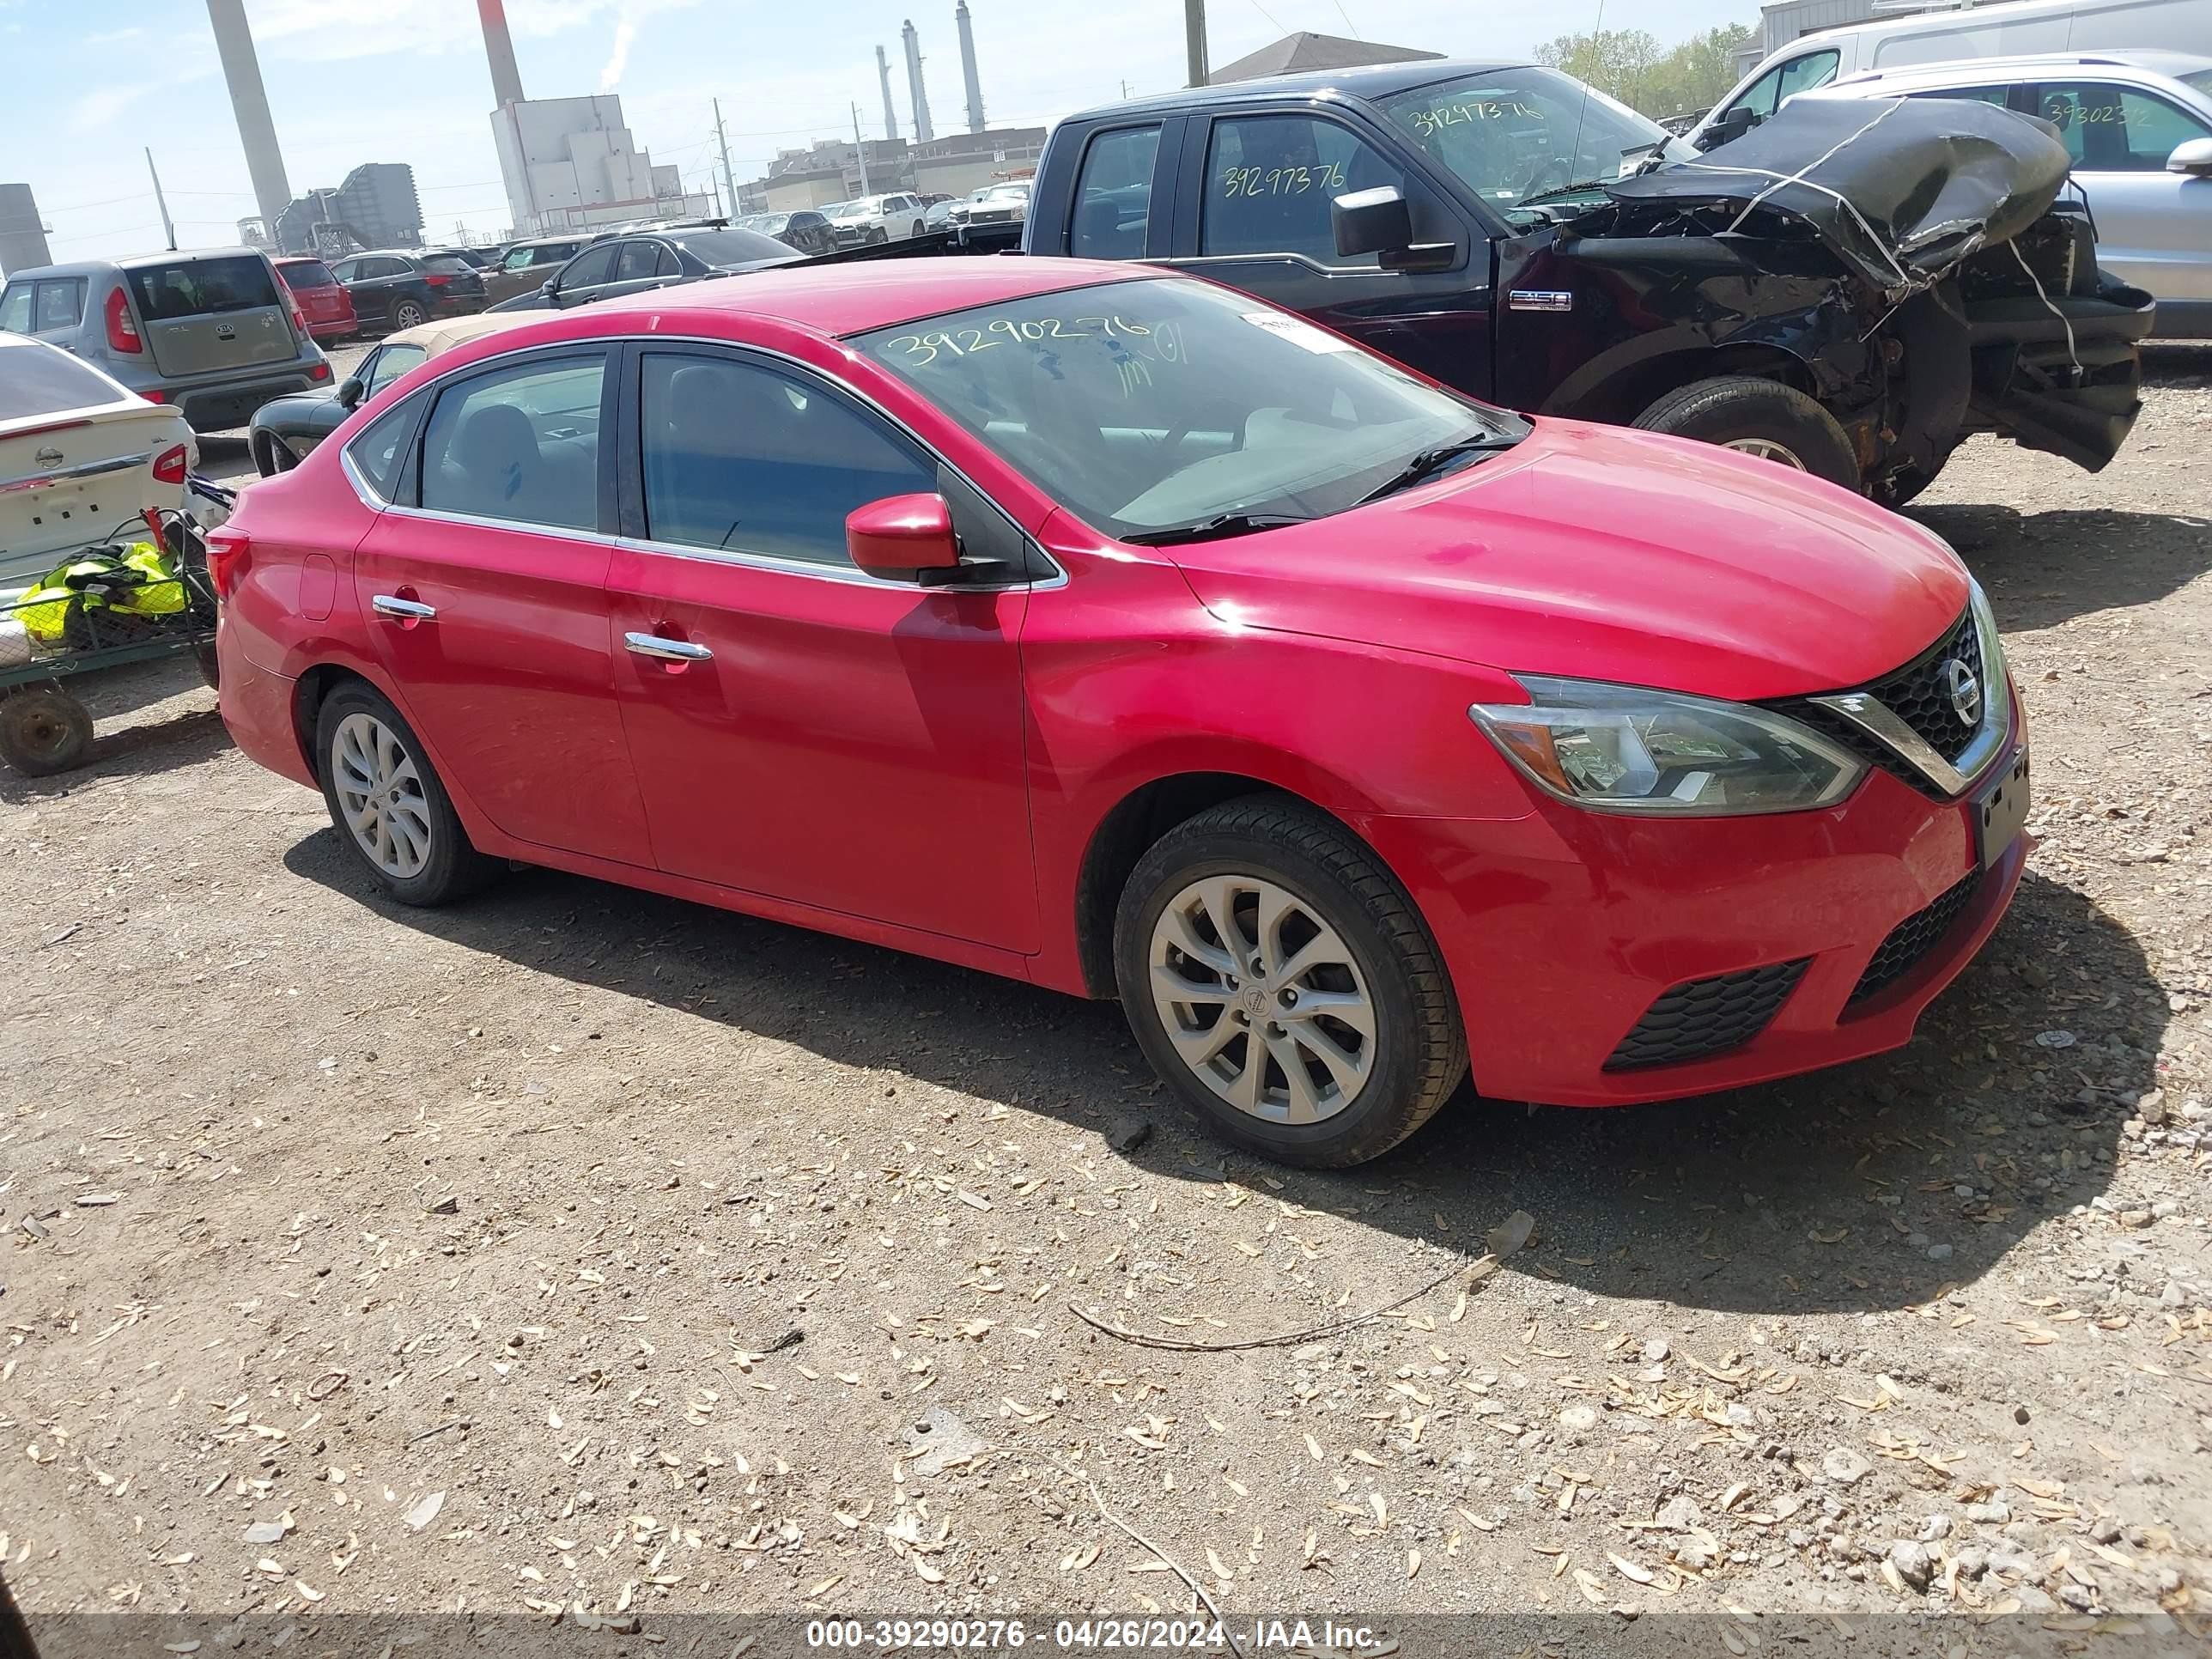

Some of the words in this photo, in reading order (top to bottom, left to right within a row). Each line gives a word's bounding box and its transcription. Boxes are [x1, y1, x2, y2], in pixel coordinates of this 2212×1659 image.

[1407, 102, 1545, 137] 39297376
[1224, 161, 1345, 198] 39297376
[887, 315, 1151, 367] 39290276
